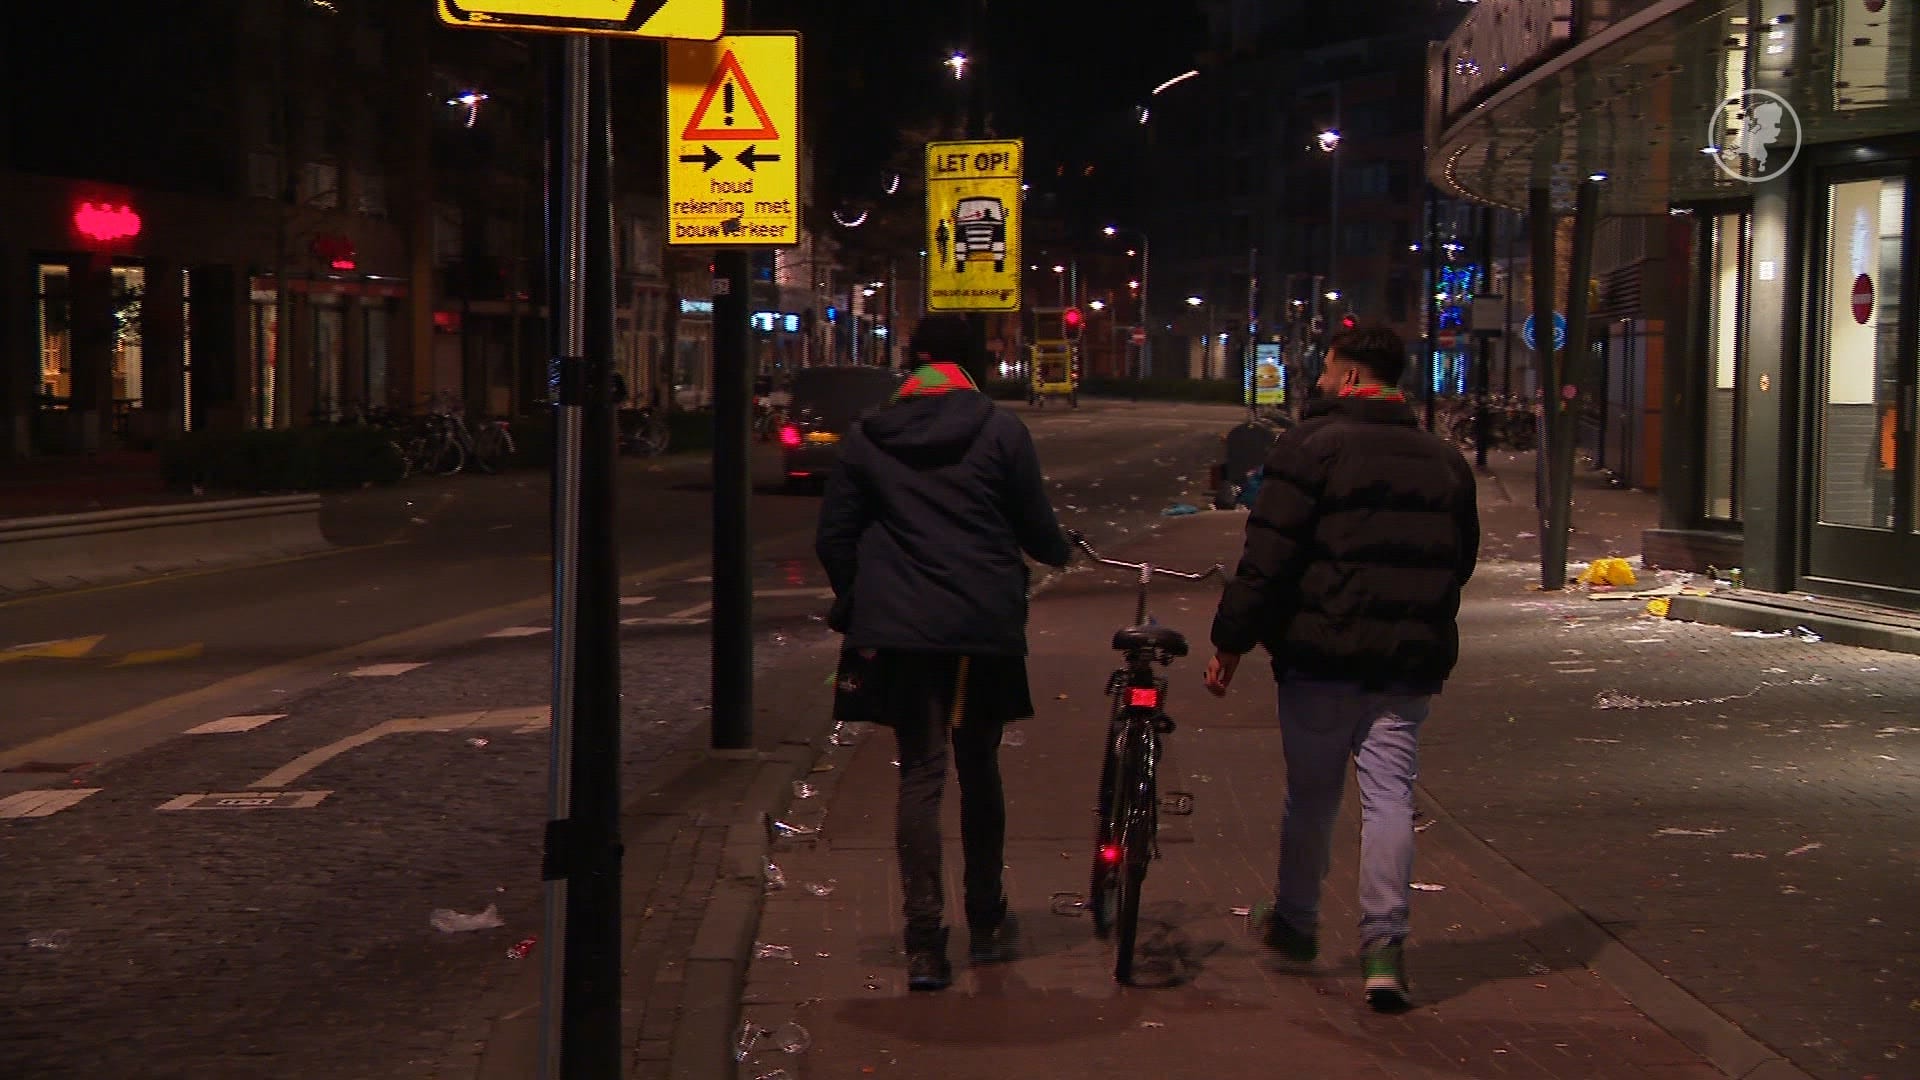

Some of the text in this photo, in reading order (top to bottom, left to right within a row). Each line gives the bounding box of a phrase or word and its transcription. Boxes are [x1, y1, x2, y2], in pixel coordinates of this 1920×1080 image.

[937, 152, 1009, 172] LET OP!
[711, 178, 753, 194] houd
[673, 198, 790, 218] rekening met
